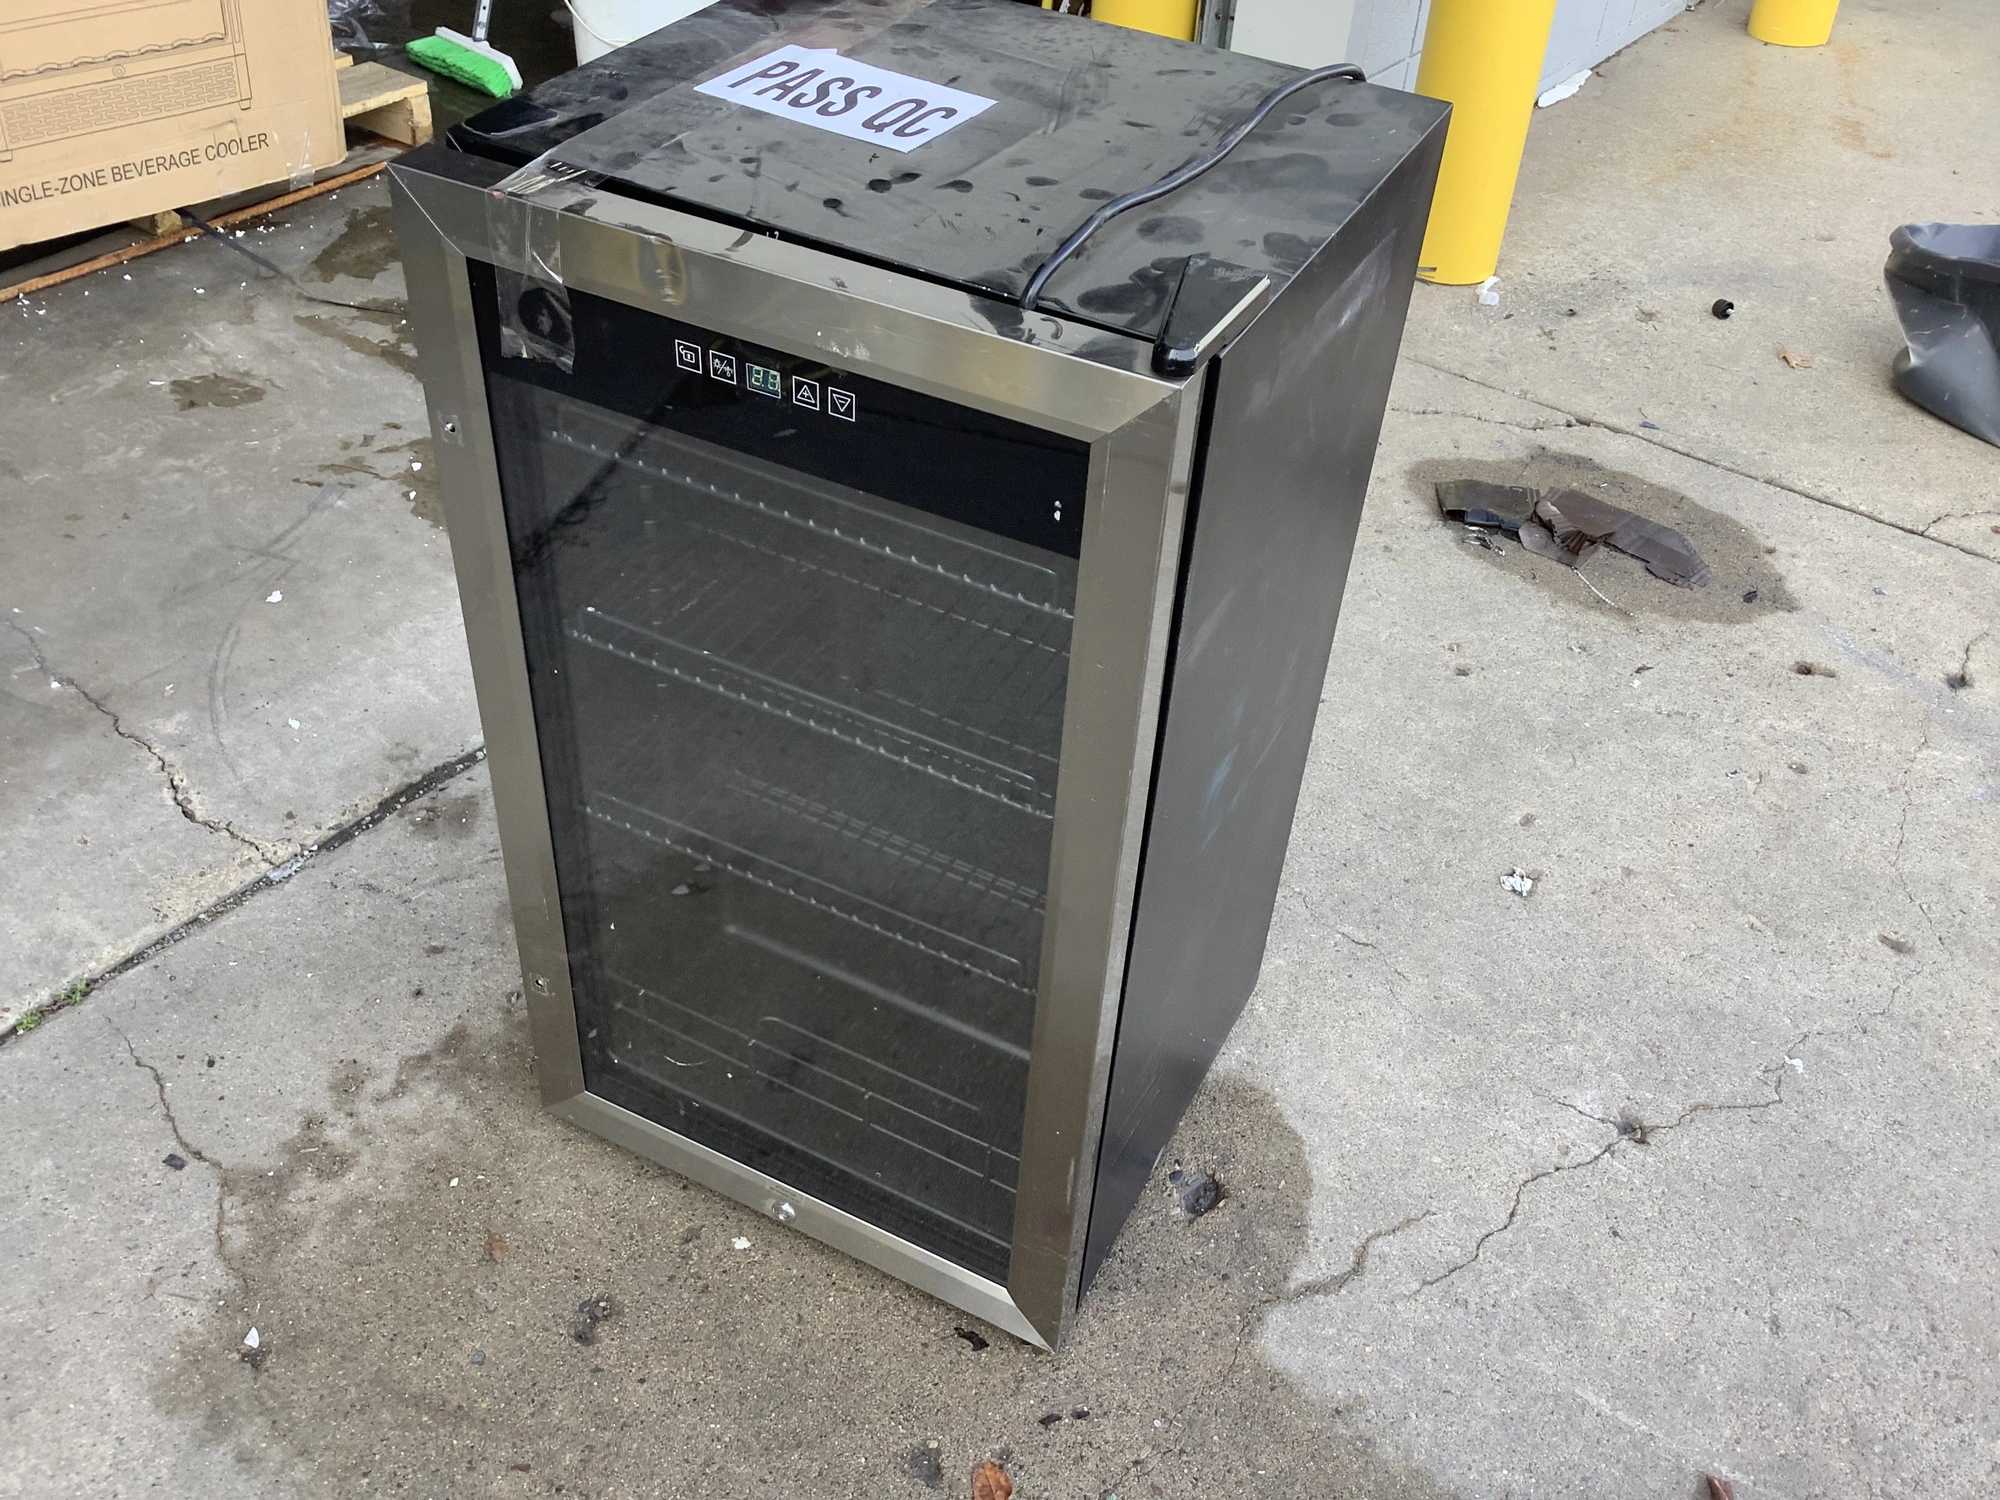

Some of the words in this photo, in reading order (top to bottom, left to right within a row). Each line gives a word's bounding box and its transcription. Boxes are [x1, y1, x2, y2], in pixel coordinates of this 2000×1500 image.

[727, 60, 883, 117] PASS
[861, 98, 958, 138] QC
[0, 169, 108, 208] INGLE-ZONE
[111, 148, 202, 183] BEVERAGE
[205, 132, 270, 161] COOLER
